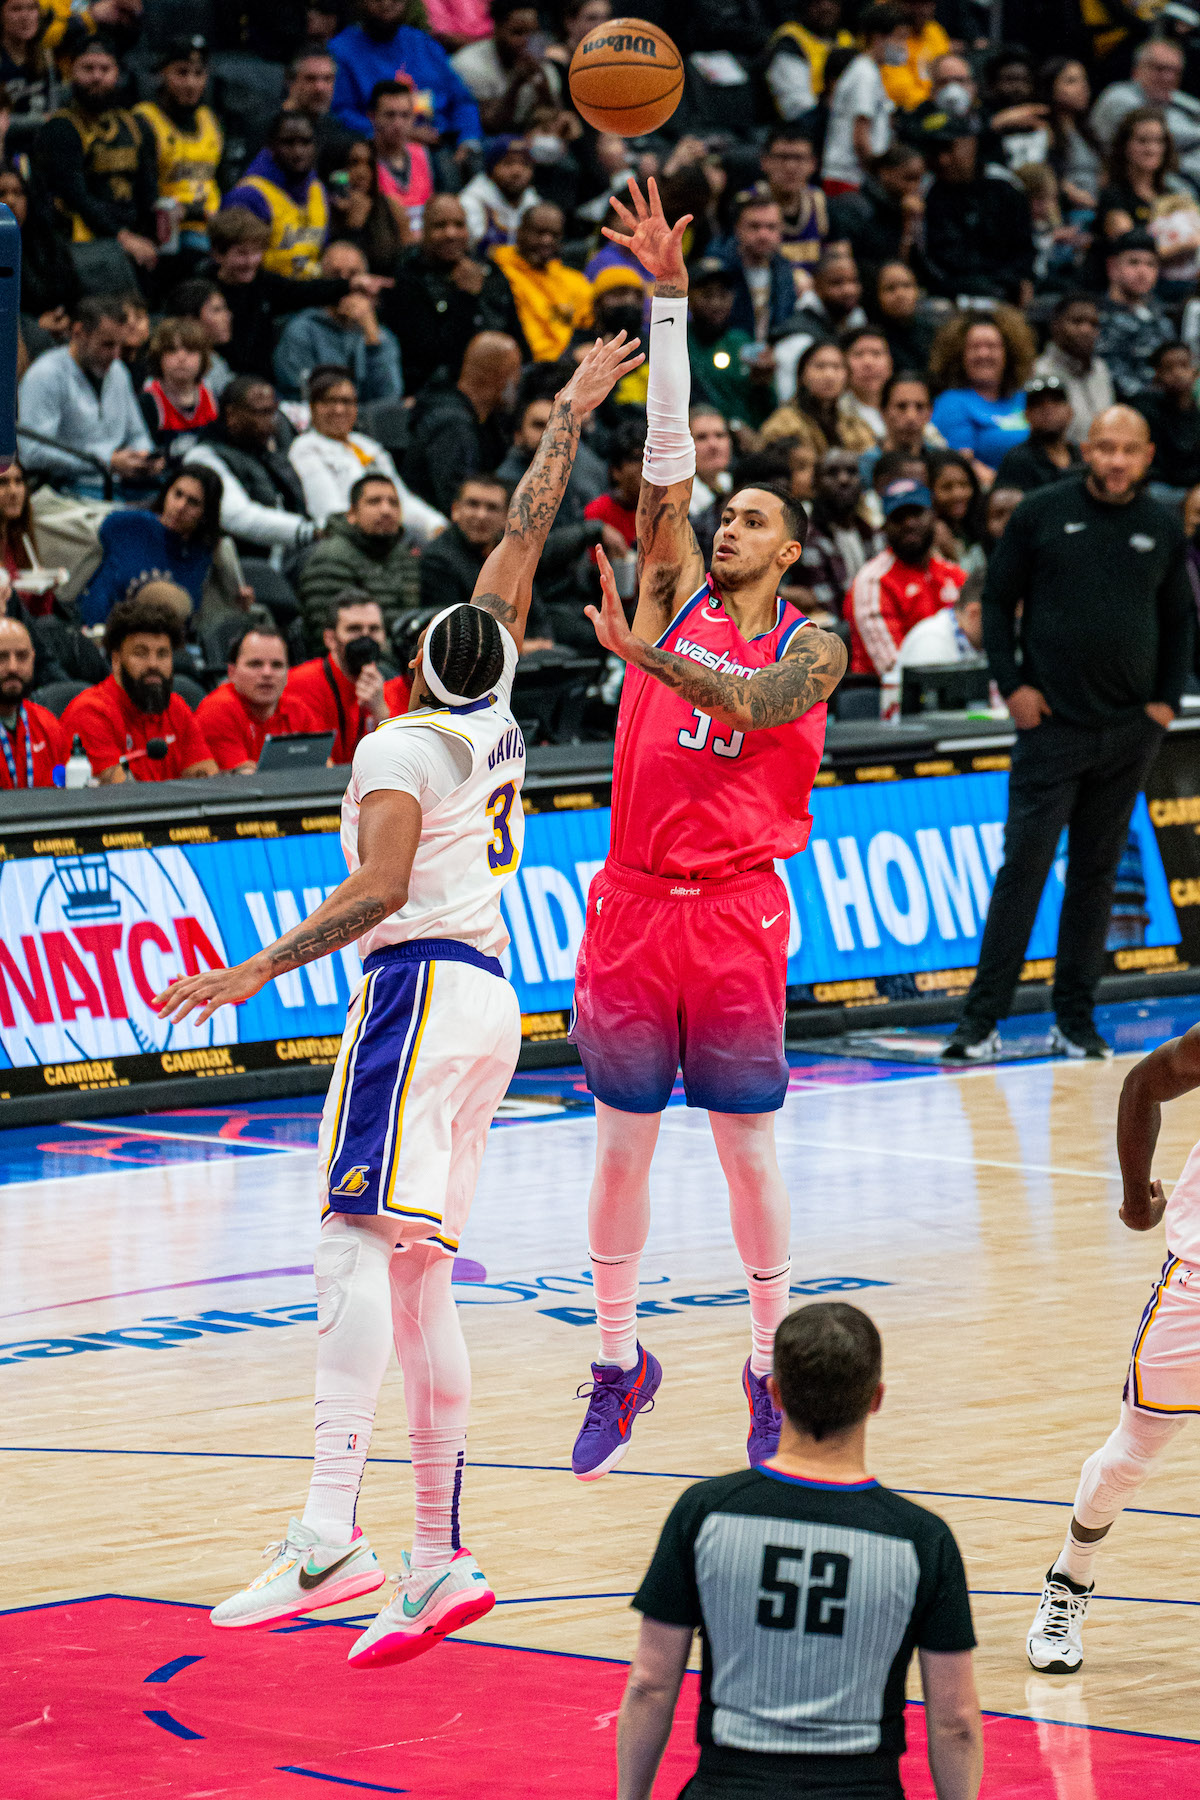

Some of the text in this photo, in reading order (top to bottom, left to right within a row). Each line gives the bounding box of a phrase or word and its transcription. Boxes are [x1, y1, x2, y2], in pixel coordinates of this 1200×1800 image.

[583, 35, 657, 58] Wilson
[488, 727, 524, 771] DAVIS
[485, 779, 520, 877] 3
[757, 1545, 850, 1639] 52
